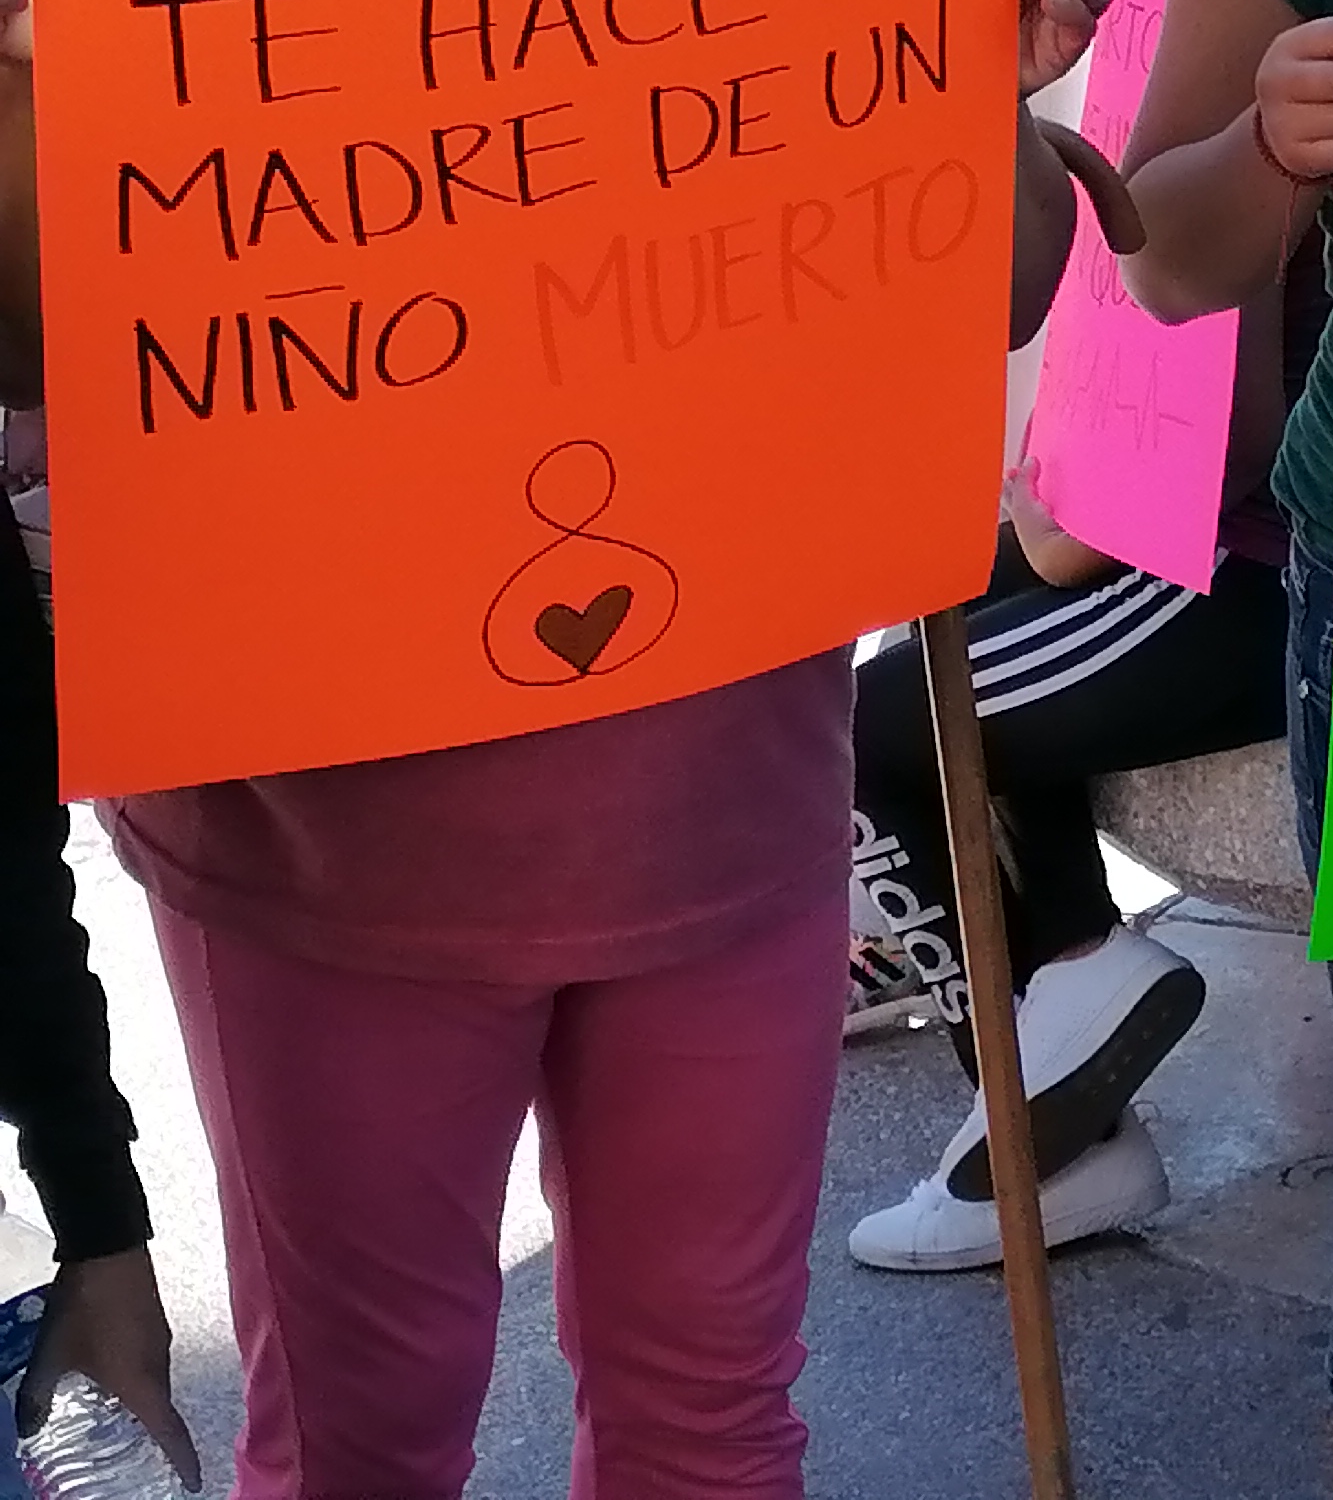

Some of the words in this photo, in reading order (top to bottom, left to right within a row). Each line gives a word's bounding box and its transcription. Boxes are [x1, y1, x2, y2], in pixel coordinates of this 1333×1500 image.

[117, 102, 598, 260] MADRE
[649, 66, 791, 188] DE
[134, 285, 470, 434] NIÑO
[531, 158, 980, 386] MUERTO
[851, 808, 974, 1026] didas
